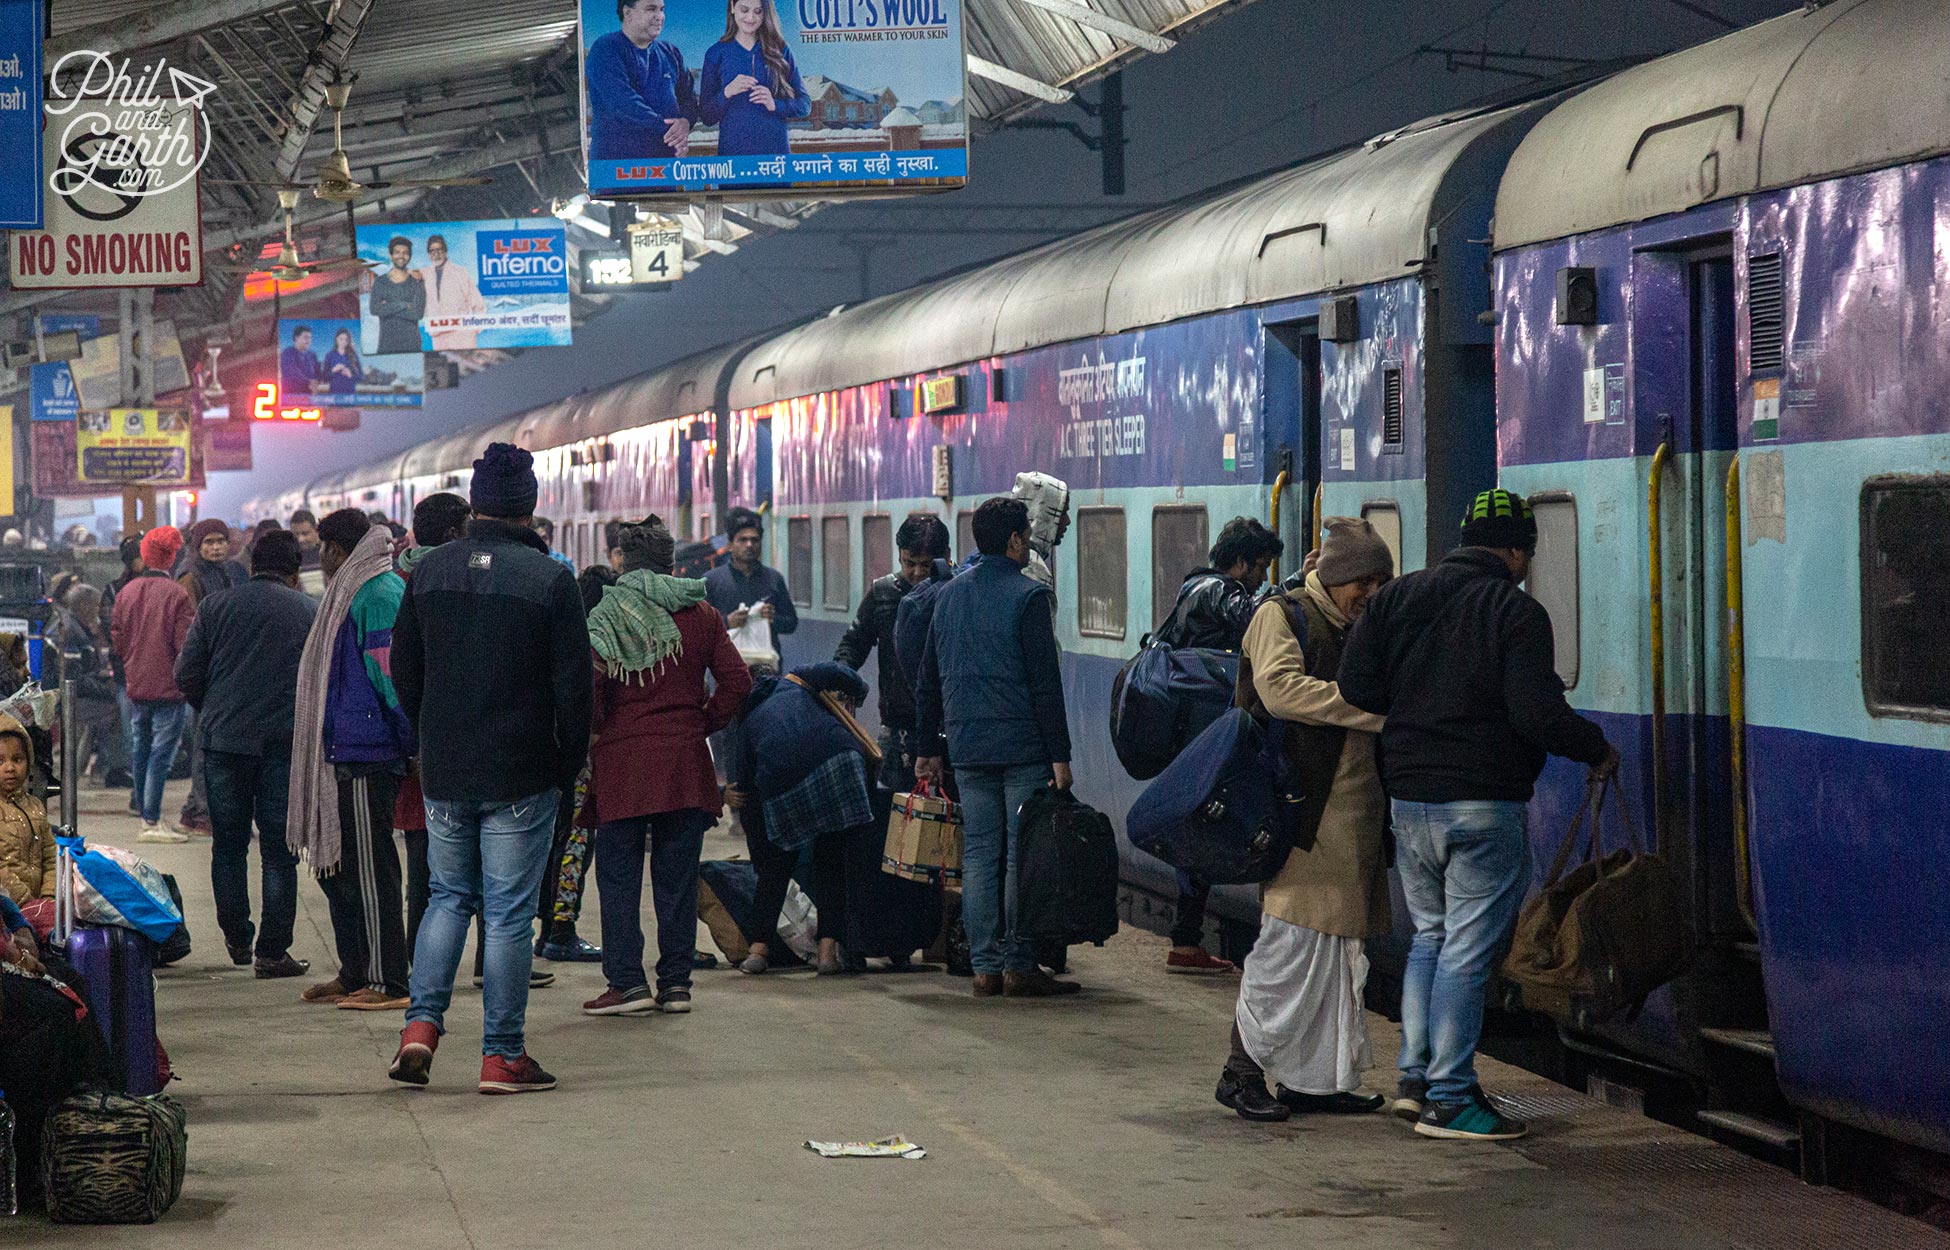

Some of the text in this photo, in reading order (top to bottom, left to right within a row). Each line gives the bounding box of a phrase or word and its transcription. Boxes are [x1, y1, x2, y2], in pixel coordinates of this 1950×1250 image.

[801, 29, 949, 44] THE BEST WARMER TO YOUR SKIN
[616, 165, 666, 181] LUX
[792, 154, 832, 175] भगाने
[838, 158, 857, 173] का
[863, 153, 891, 176] सही
[19, 231, 192, 276] NO SMOKING
[494, 237, 554, 254] LUX
[482, 253, 565, 276] Inferno
[648, 250, 669, 277] 4
[491, 280, 520, 289] QUILTED
[430, 317, 460, 327] LUX
[462, 316, 496, 327] Inferno
[1115, 414, 1146, 457] SLEEPER
